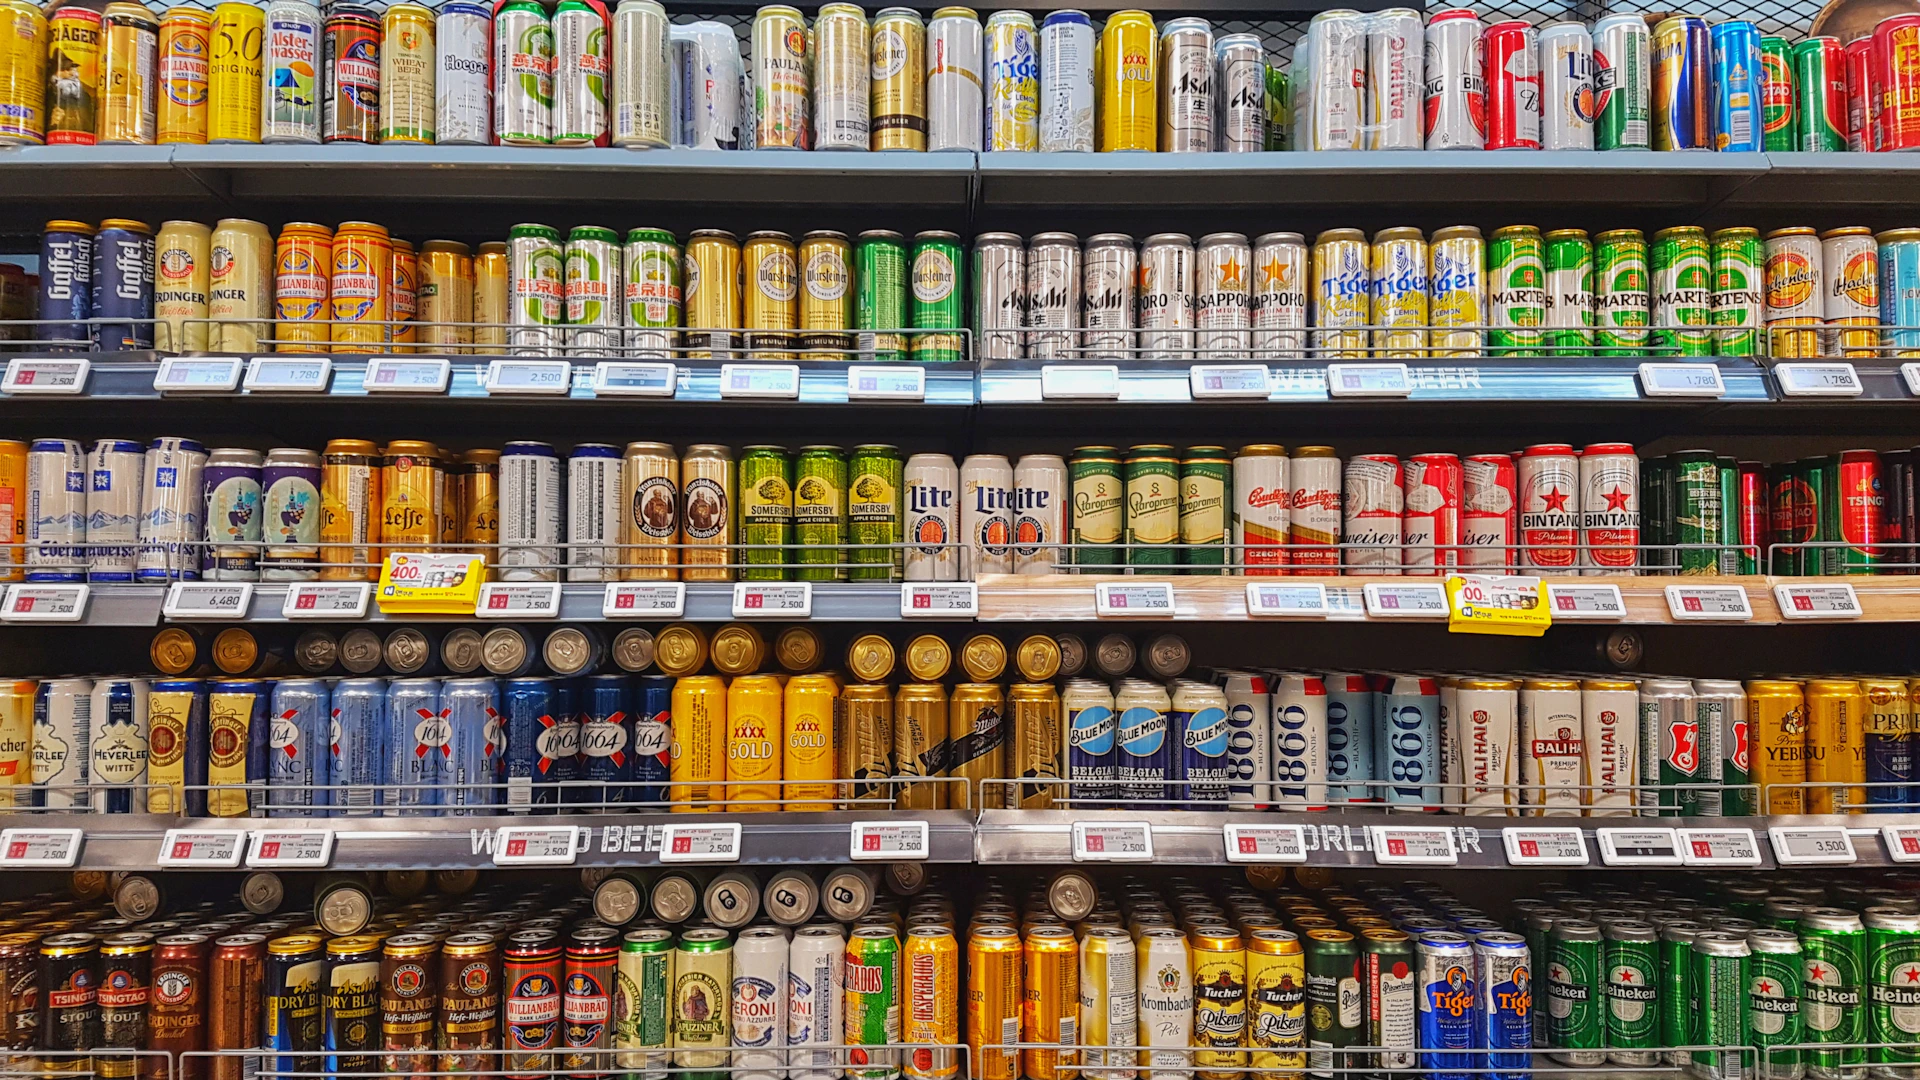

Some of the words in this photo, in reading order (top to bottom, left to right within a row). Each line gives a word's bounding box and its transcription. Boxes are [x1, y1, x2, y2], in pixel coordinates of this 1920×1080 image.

[271, 31, 314, 50] Alster-
[270, 45, 314, 64] wasser
[1123, 54, 1148, 66] XXXX
[392, 57, 428, 69] WHEAT
[397, 66, 422, 75] BEER
[1115, 67, 1152, 82] GOLD
[1015, 93, 1036, 103] LEMON
[47, 240, 72, 300] Gaffel
[117, 240, 142, 300] Gaffel
[807, 268, 848, 286] Warsteiner
[913, 269, 952, 285] Warsteiner
[1394, 309, 1419, 317] LEMON
[1435, 307, 1462, 318] LEMON
[910, 486, 952, 514] Lite
[750, 504, 792, 517] SOMERSBY
[795, 503, 834, 517] SOMERSBY
[850, 502, 892, 516] SOMERSBY
[384, 506, 424, 531] Leffe
[867, 513, 888, 522] CIDER
[1539, 531, 1570, 541] Pilsener
[1600, 531, 1631, 541] Pilsener
[1248, 551, 1280, 559] CZECH
[1293, 551, 1323, 559] CZECH
[390, 566, 419, 580] 400
[733, 725, 766, 739] XXXX
[795, 722, 821, 733] XXXX
[1070, 725, 1099, 745] BLUE
[1117, 728, 1141, 745] BLUE
[1141, 716, 1167, 735] MOON
[581, 731, 621, 750] 1664
[789, 733, 827, 749] GOLD
[1185, 728, 1214, 747] BLUE
[94, 748, 148, 763] HEVERLEE
[728, 741, 774, 760] GOLD
[1277, 705, 1308, 801] 1866
[1391, 705, 1425, 801] 1866
[1118, 765, 1165, 777] BELGIAN
[157, 972, 190, 987] ERDINGER
[913, 953, 935, 1023] DESPERADOS
[1204, 986, 1243, 1000] Tucher
[280, 995, 312, 1010] DRY
[326, 995, 350, 1010] DRY
[1140, 994, 1194, 1012] Krombacher
[1266, 989, 1303, 1003] Tucher
[100, 1010, 141, 1024] STOUT
[1156, 1021, 1182, 1040] Pils
